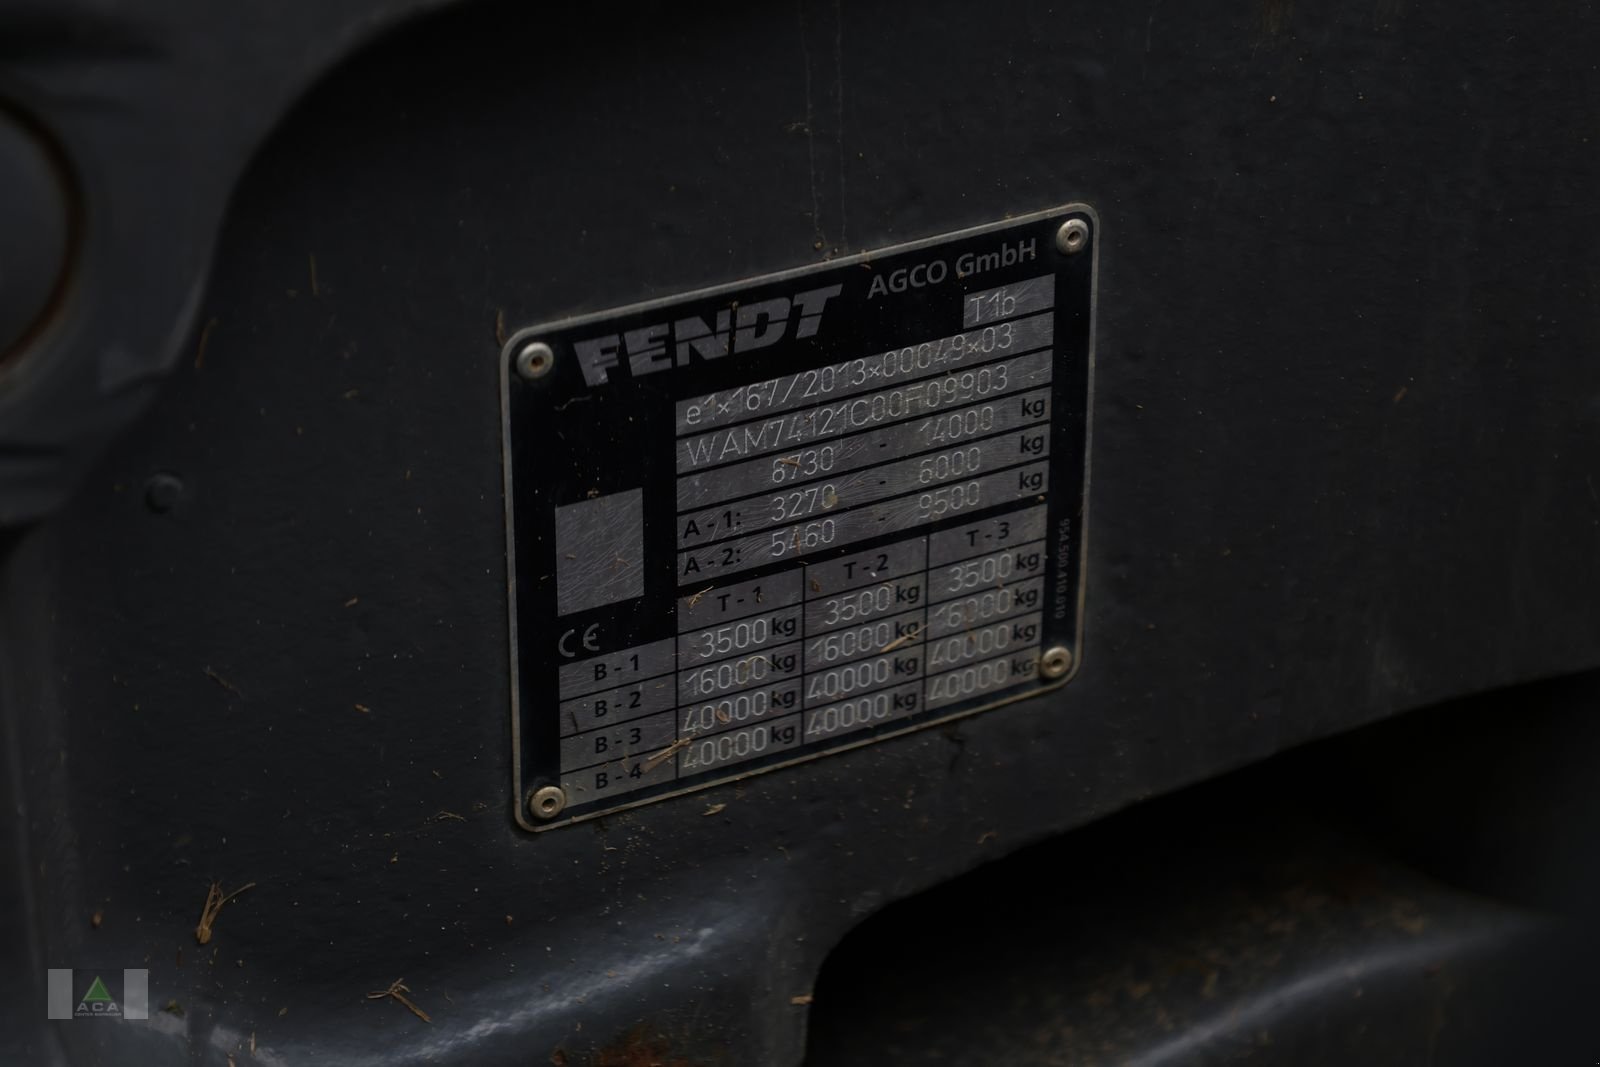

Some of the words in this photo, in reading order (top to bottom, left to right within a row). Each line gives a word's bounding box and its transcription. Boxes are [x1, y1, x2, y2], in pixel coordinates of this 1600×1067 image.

[866, 258, 948, 299] AGCO
[955, 237, 1037, 278] GmbH
[573, 283, 844, 387] FENDT
[919, 406, 994, 446] 14000
[1021, 398, 1046, 418] kg
[771, 484, 836, 522] 3270
[919, 447, 981, 483] 6000
[1020, 435, 1045, 455] kg
[1018, 471, 1044, 490] kg
[685, 656, 768, 695] 16000
[771, 653, 796, 674] kg
[809, 622, 891, 661] 16000
[1014, 587, 1038, 607] kg
[699, 619, 767, 658] 3500
[771, 617, 796, 637] kg
[824, 586, 891, 625] 3500
[895, 585, 920, 604] kg
[950, 553, 1012, 592] 3500
[1015, 551, 1040, 571] kg
[683, 691, 768, 733] 40000
[770, 689, 796, 709] kg
[806, 658, 890, 700] 40000
[893, 655, 919, 675] kg
[930, 624, 1010, 667] 40000
[1013, 622, 1037, 642] kg
[683, 727, 768, 769] 40000
[770, 725, 795, 745] kg
[806, 693, 889, 735] 40000
[892, 691, 918, 711] kg
[930, 659, 1009, 701] 40000
